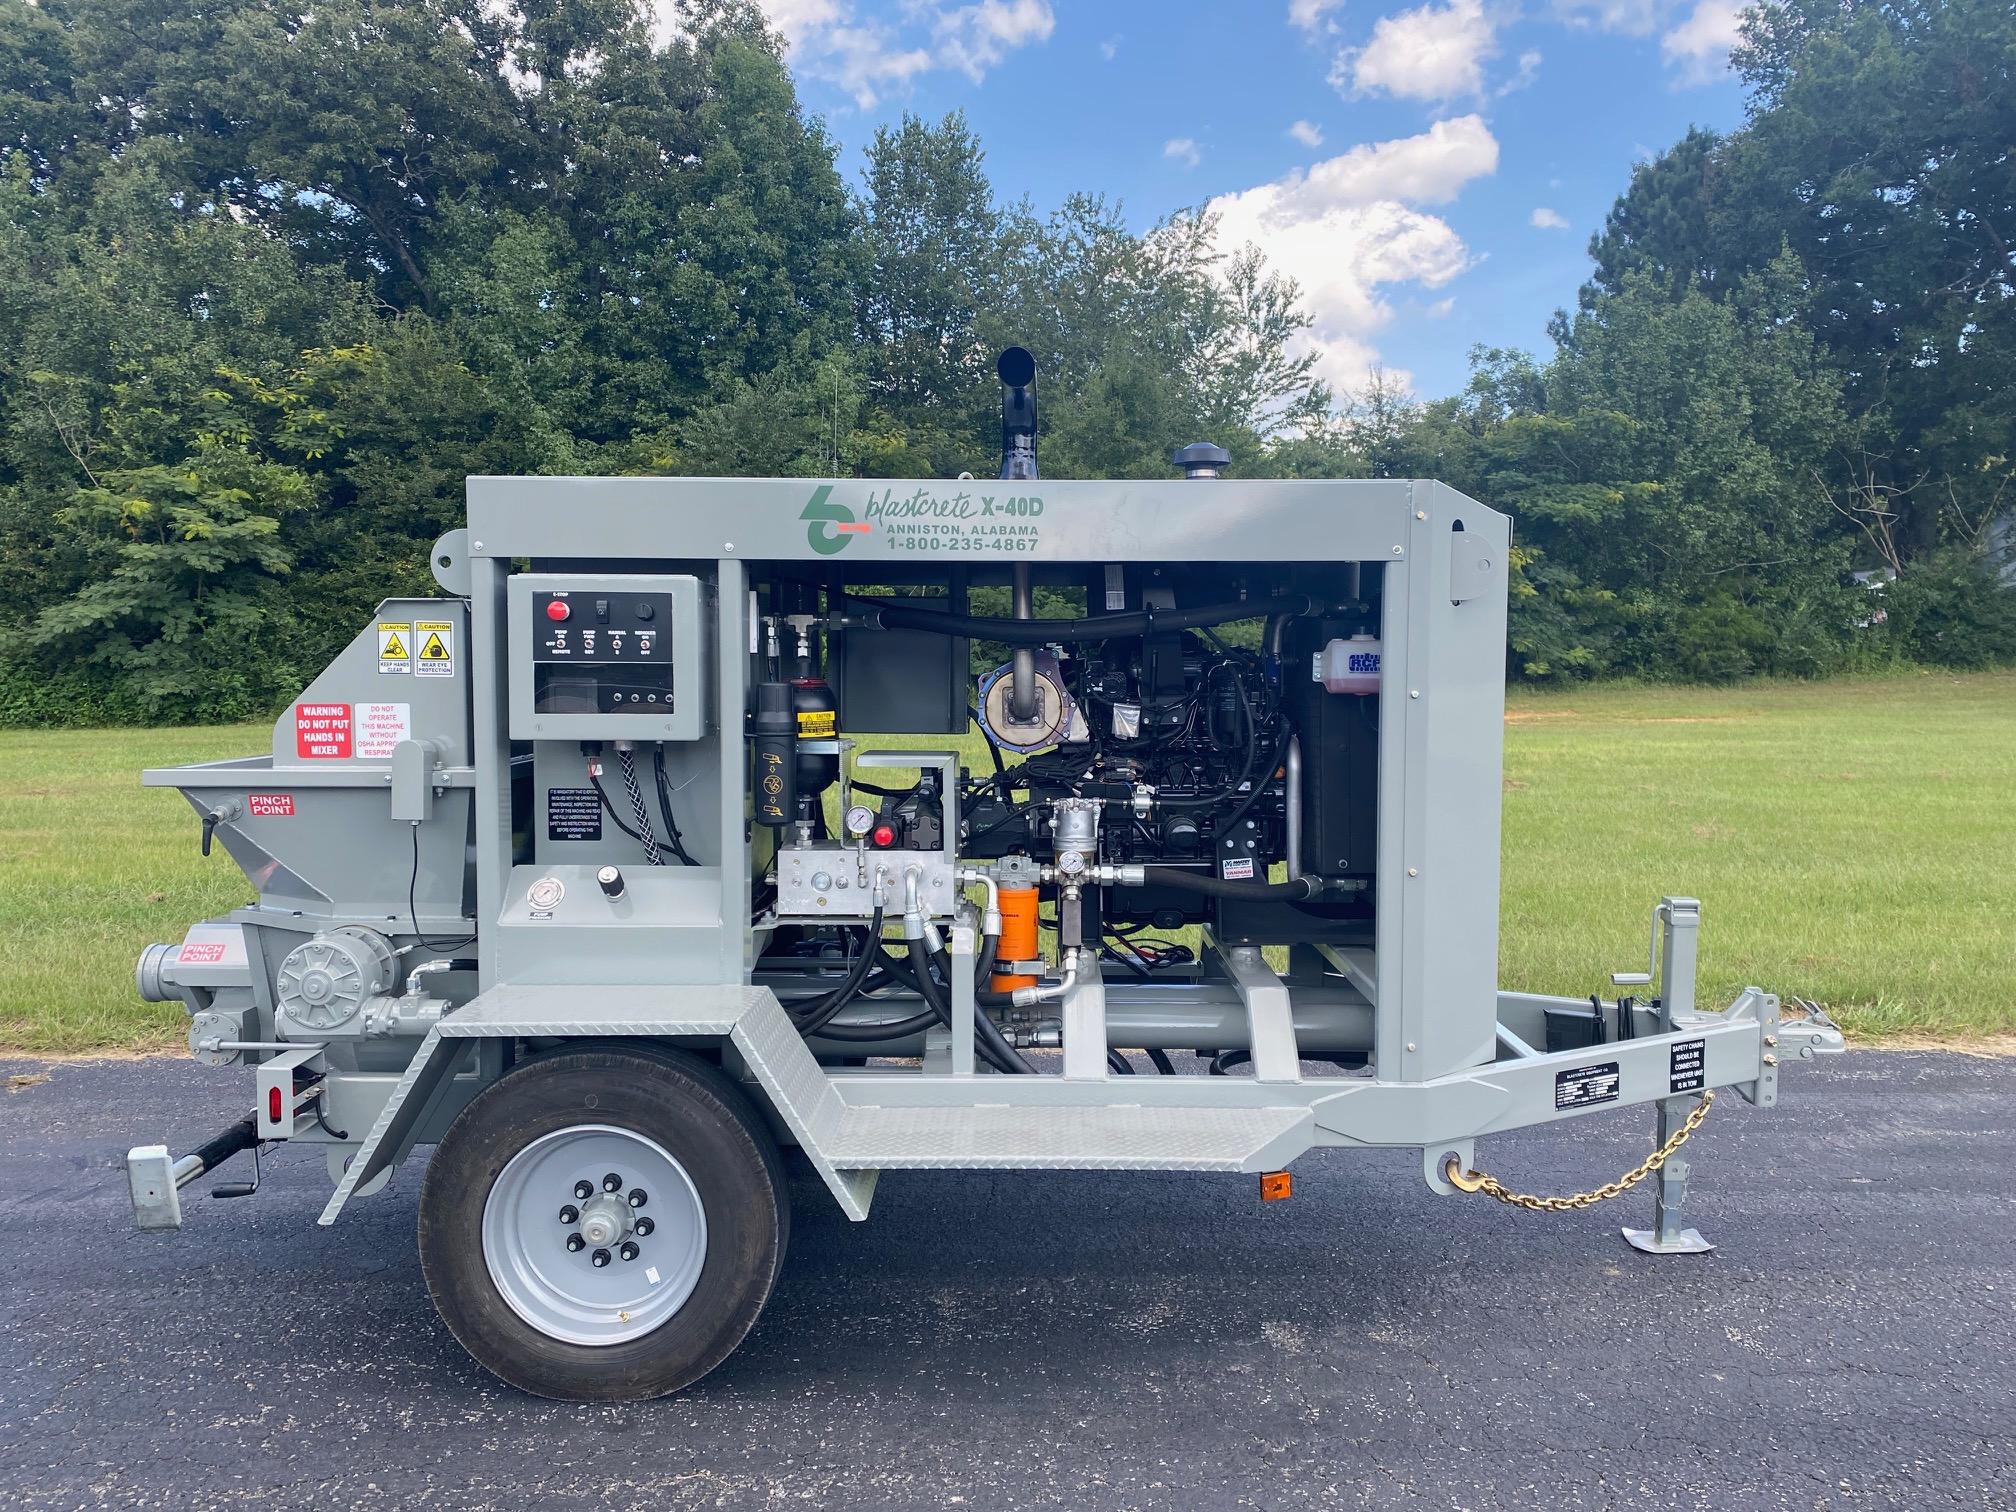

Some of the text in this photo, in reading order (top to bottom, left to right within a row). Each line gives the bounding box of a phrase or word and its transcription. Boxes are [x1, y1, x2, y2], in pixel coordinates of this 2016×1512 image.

[865, 489, 1043, 526] blastcrete X-40D
[887, 525, 1038, 536] ANNISTON, ALABAMA
[888, 538, 1038, 551] 1-800-235-4867
[303, 707, 343, 716] WARNING
[299, 720, 349, 729] DO NOT PUT
[304, 733, 344, 742] HANDS IN
[311, 746, 338, 754] MIXER
[251, 796, 290, 805] PINCH
[253, 806, 291, 814] POINT
[1673, 1044, 1688, 1052] SAFETY
[1676, 1053, 1693, 1061] SHOULD
[1675, 1061, 1700, 1070] CONNECTED
[1671, 1071, 1694, 1080] WHENEVER
